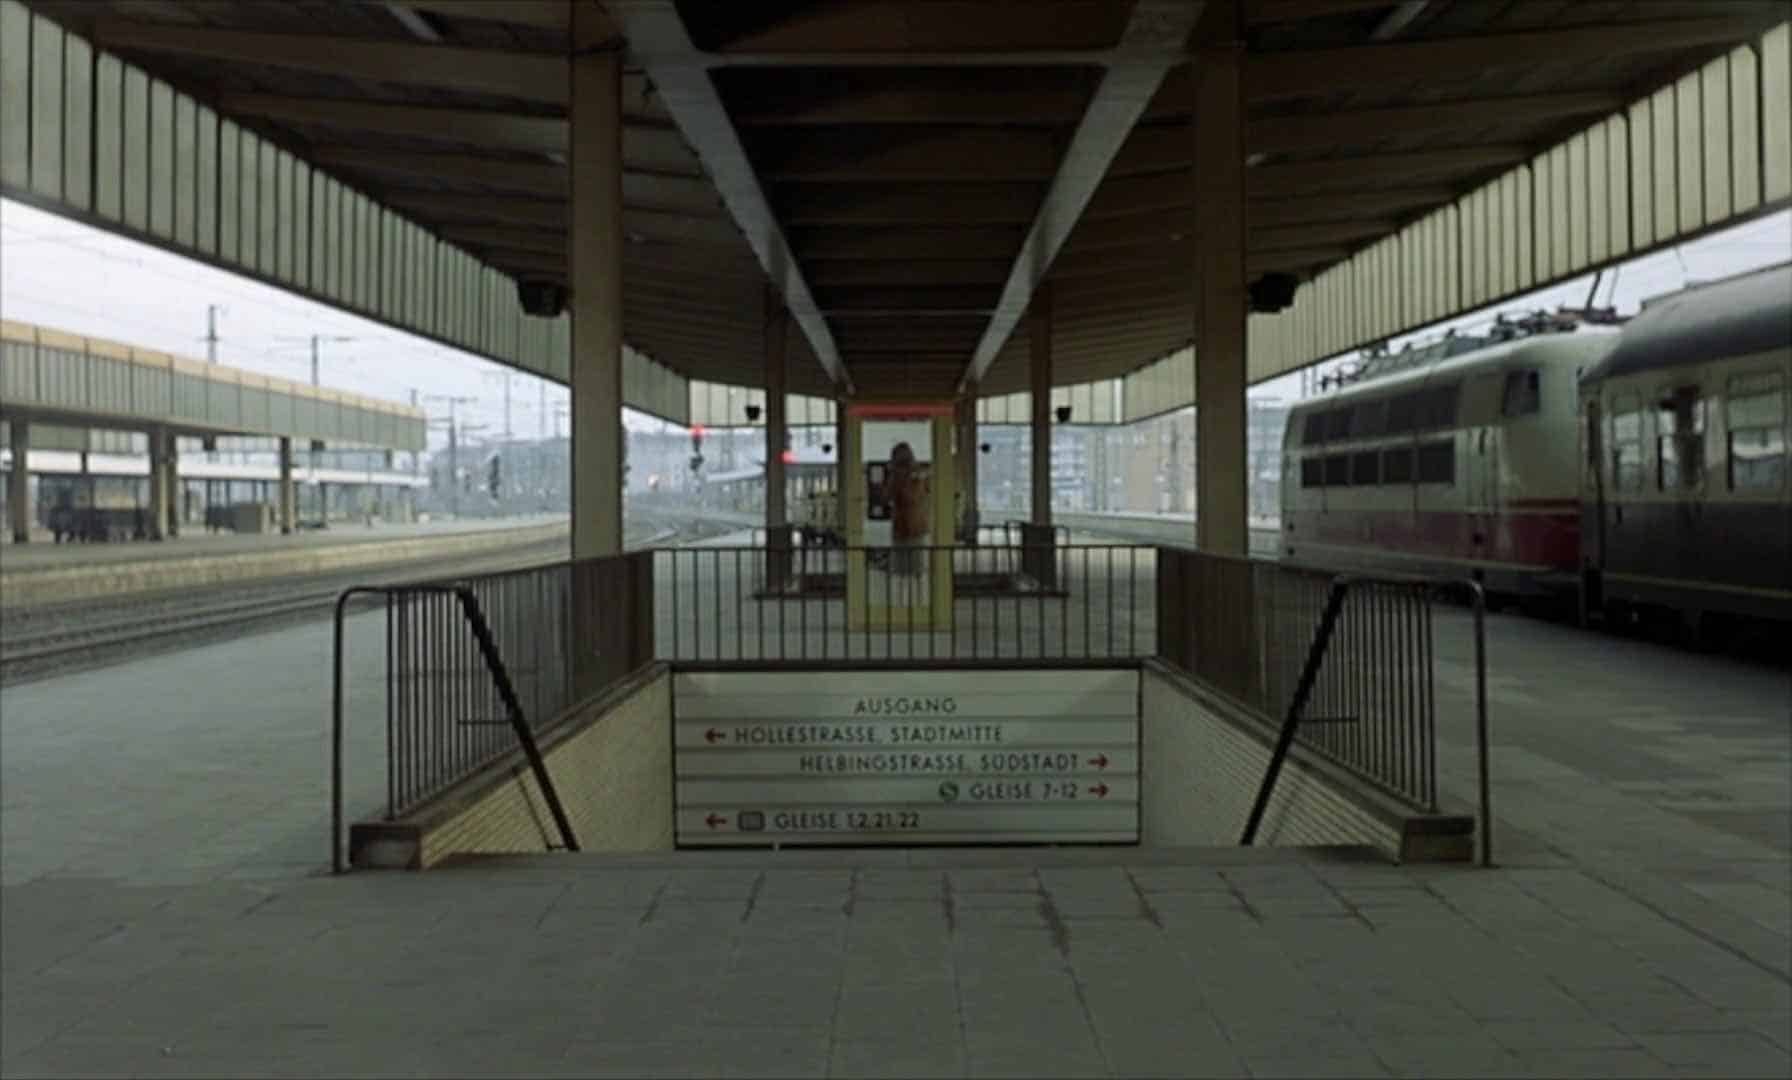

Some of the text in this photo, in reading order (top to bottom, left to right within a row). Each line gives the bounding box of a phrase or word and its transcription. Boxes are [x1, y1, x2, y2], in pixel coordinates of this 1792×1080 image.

[855, 697, 958, 714] AUSGANG
[891, 726, 1001, 743] STADTMITTE
[970, 783, 1032, 800] GLEISE
[1044, 783, 1078, 800] 7-12
[775, 812, 840, 829] GLEISE
